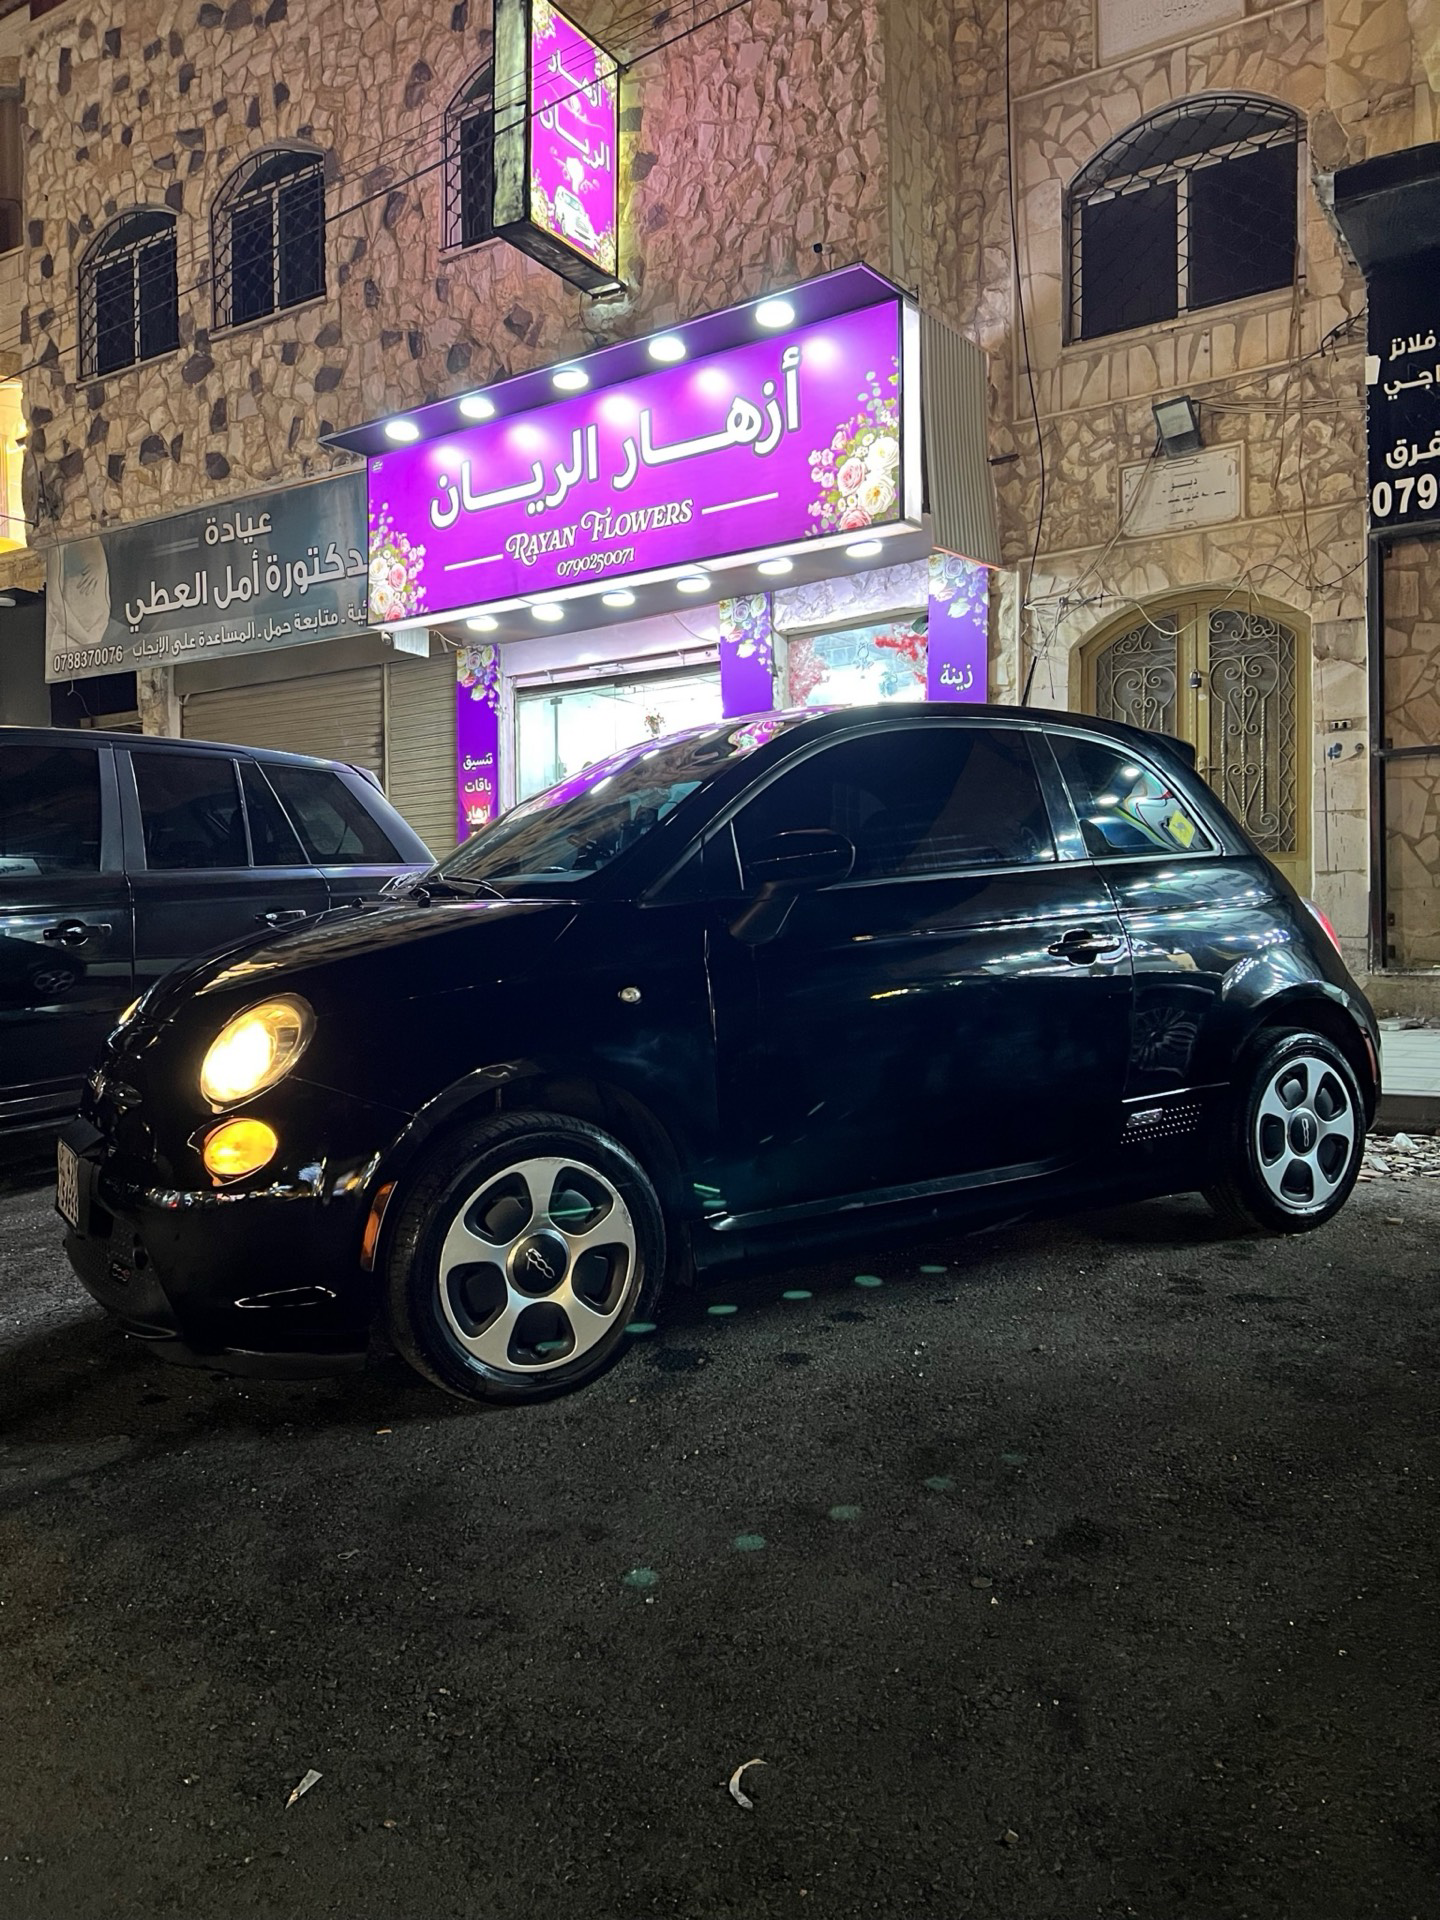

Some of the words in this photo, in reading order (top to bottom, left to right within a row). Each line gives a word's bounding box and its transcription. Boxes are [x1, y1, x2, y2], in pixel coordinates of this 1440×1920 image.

[612, 346, 802, 492] أزهار
[429, 424, 599, 530] الريان
[1372, 473, 1438, 518] 079
[205, 511, 273, 546] عيادة
[505, 525, 578, 566] RAYAN
[581, 499, 694, 542] FLOWERS
[266, 543, 367, 597] دكتورة
[557, 547, 635, 577] 0790250071
[212, 550, 260, 610] أمل
[125, 571, 208, 633] العطي
[199, 621, 255, 648] المساعدة
[263, 618, 292, 642] حمل
[294, 607, 338, 634] متابعة
[54, 645, 123, 672] 0788370076
[132, 635, 169, 661] الإنجاب
[171, 632, 196, 656] على
[940, 663, 974, 691] زينة
[463, 752, 493, 771] تنسيق
[464, 777, 492, 795] باقات
